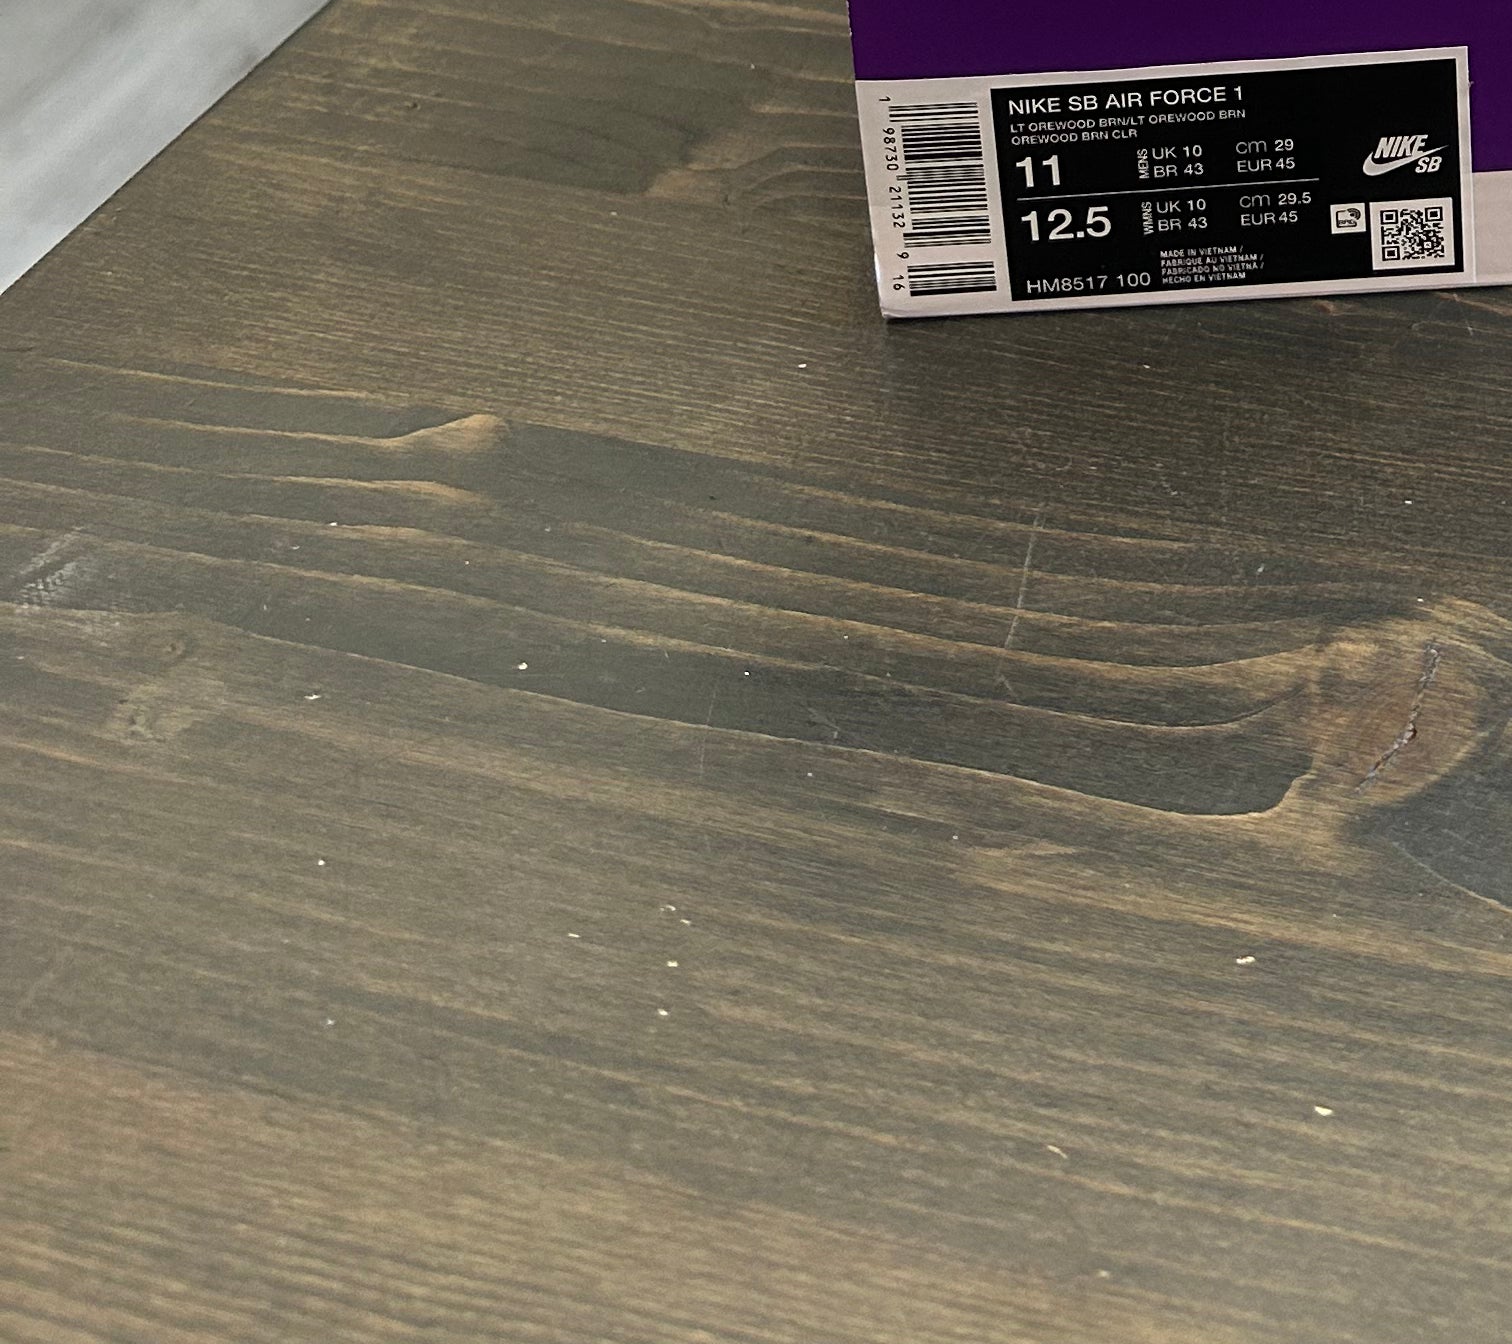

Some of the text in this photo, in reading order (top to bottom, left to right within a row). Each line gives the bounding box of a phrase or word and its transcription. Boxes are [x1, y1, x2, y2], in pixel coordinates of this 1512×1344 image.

[1008, 85, 1242, 115] NIKE SB AIR FORCE 1
[1010, 109, 1246, 133] LT OREWOOD BRN/LT OREWOOD BRN
[1011, 128, 1138, 145] OREWOOD BRN CLR
[882, 127, 899, 171] 98730
[1151, 144, 1202, 160] UK 10
[1235, 138, 1294, 154] cm 29
[1374, 134, 1428, 159] NIKE
[1016, 155, 1061, 188] 11
[1137, 148, 1150, 179] MENS
[1153, 163, 1204, 178] BR 43
[1236, 157, 1295, 173] EUR 45
[1415, 156, 1442, 173] SB
[889, 186, 906, 228] 21132
[1156, 198, 1206, 213] UK 10
[1239, 192, 1312, 208] cm 29.5
[1021, 206, 1112, 241] 12.5
[1141, 201, 1154, 235] WMNS
[1158, 216, 1208, 232] BR 43
[1240, 210, 1298, 226] EUR 45
[896, 251, 909, 259] 9
[1160, 249, 1185, 258] MADE
[1187, 248, 1197, 256] IN
[1199, 246, 1237, 256] VIETNAM
[1161, 257, 1203, 267] FABRIQUE
[1220, 253, 1258, 263] VIETNAM
[893, 274, 905, 291] 16
[1026, 272, 1151, 294] HM8517 100
[1162, 272, 1246, 284] HECHO EN VIETNAM
